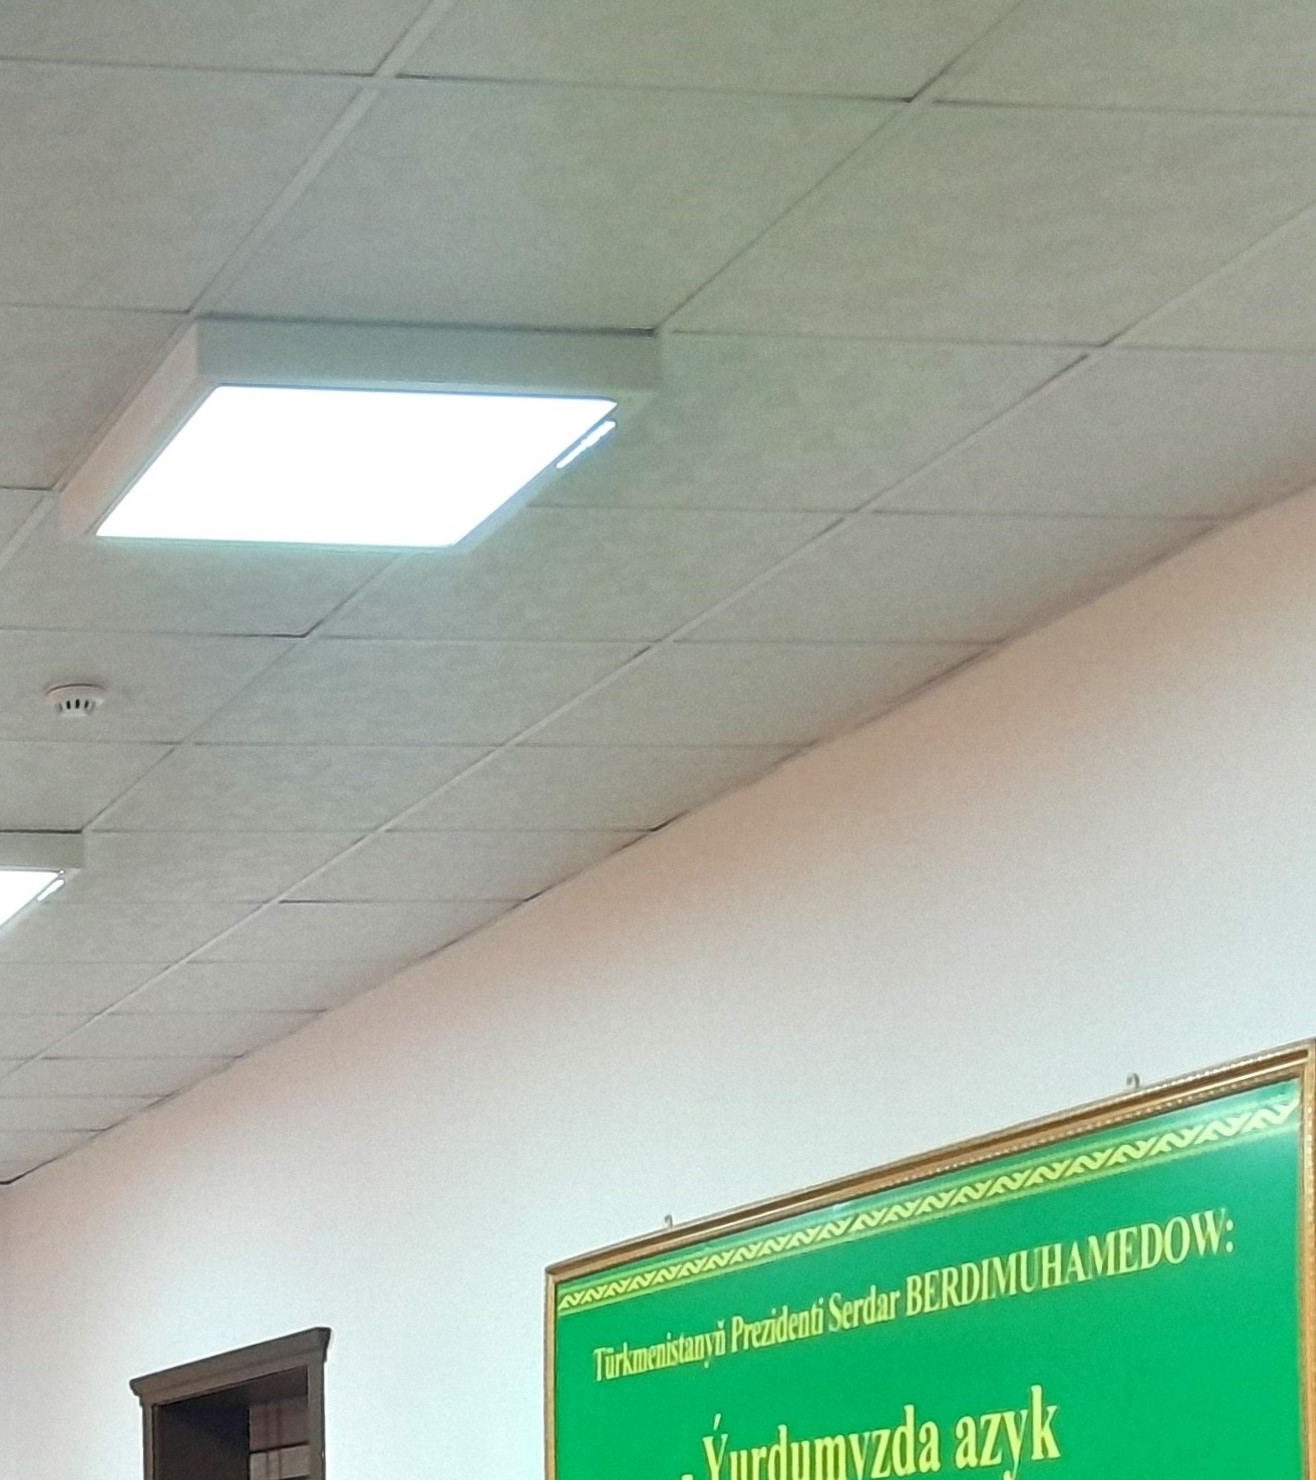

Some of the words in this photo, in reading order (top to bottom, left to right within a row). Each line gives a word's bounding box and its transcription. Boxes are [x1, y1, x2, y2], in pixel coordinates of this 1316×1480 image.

[593, 1318, 727, 1382] Türkmenistanyň
[730, 1296, 824, 1353] Prezidenti
[828, 1284, 901, 1333] Serdar
[904, 1206, 1235, 1317] BERDIMUHAMEDOW:
